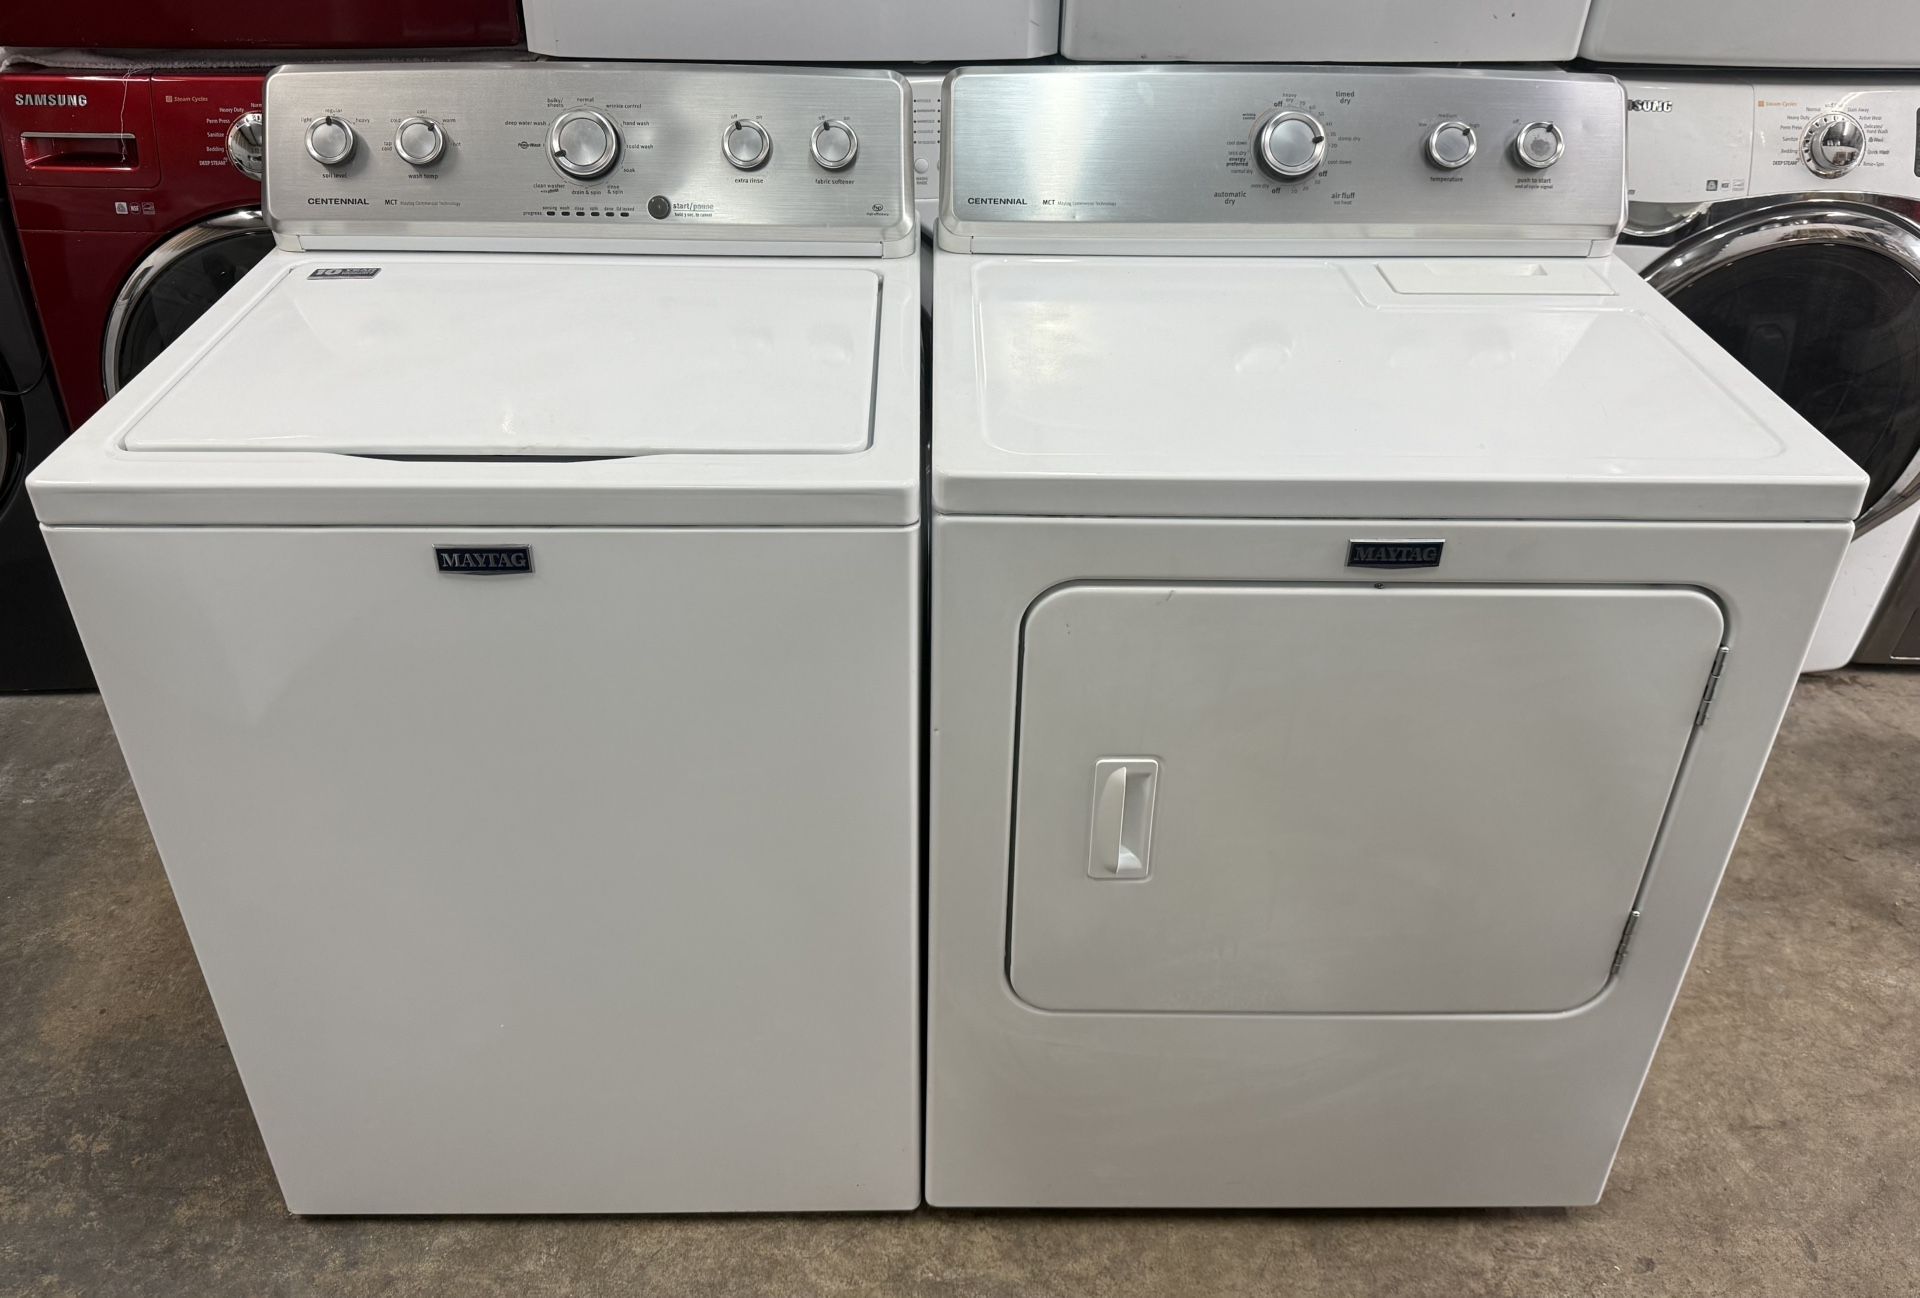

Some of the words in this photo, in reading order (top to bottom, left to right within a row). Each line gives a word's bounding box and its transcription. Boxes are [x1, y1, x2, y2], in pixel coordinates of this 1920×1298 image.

[15, 93, 88, 106] SAMSUNG
[1628, 99, 1672, 113] SUNG
[307, 197, 369, 205] CENTENNIAL
[967, 197, 1028, 205] CENTENNIAL
[1224, 198, 1235, 206] dry
[1353, 546, 1437, 561] MAYTAG
[440, 553, 526, 568] MAYTAG
